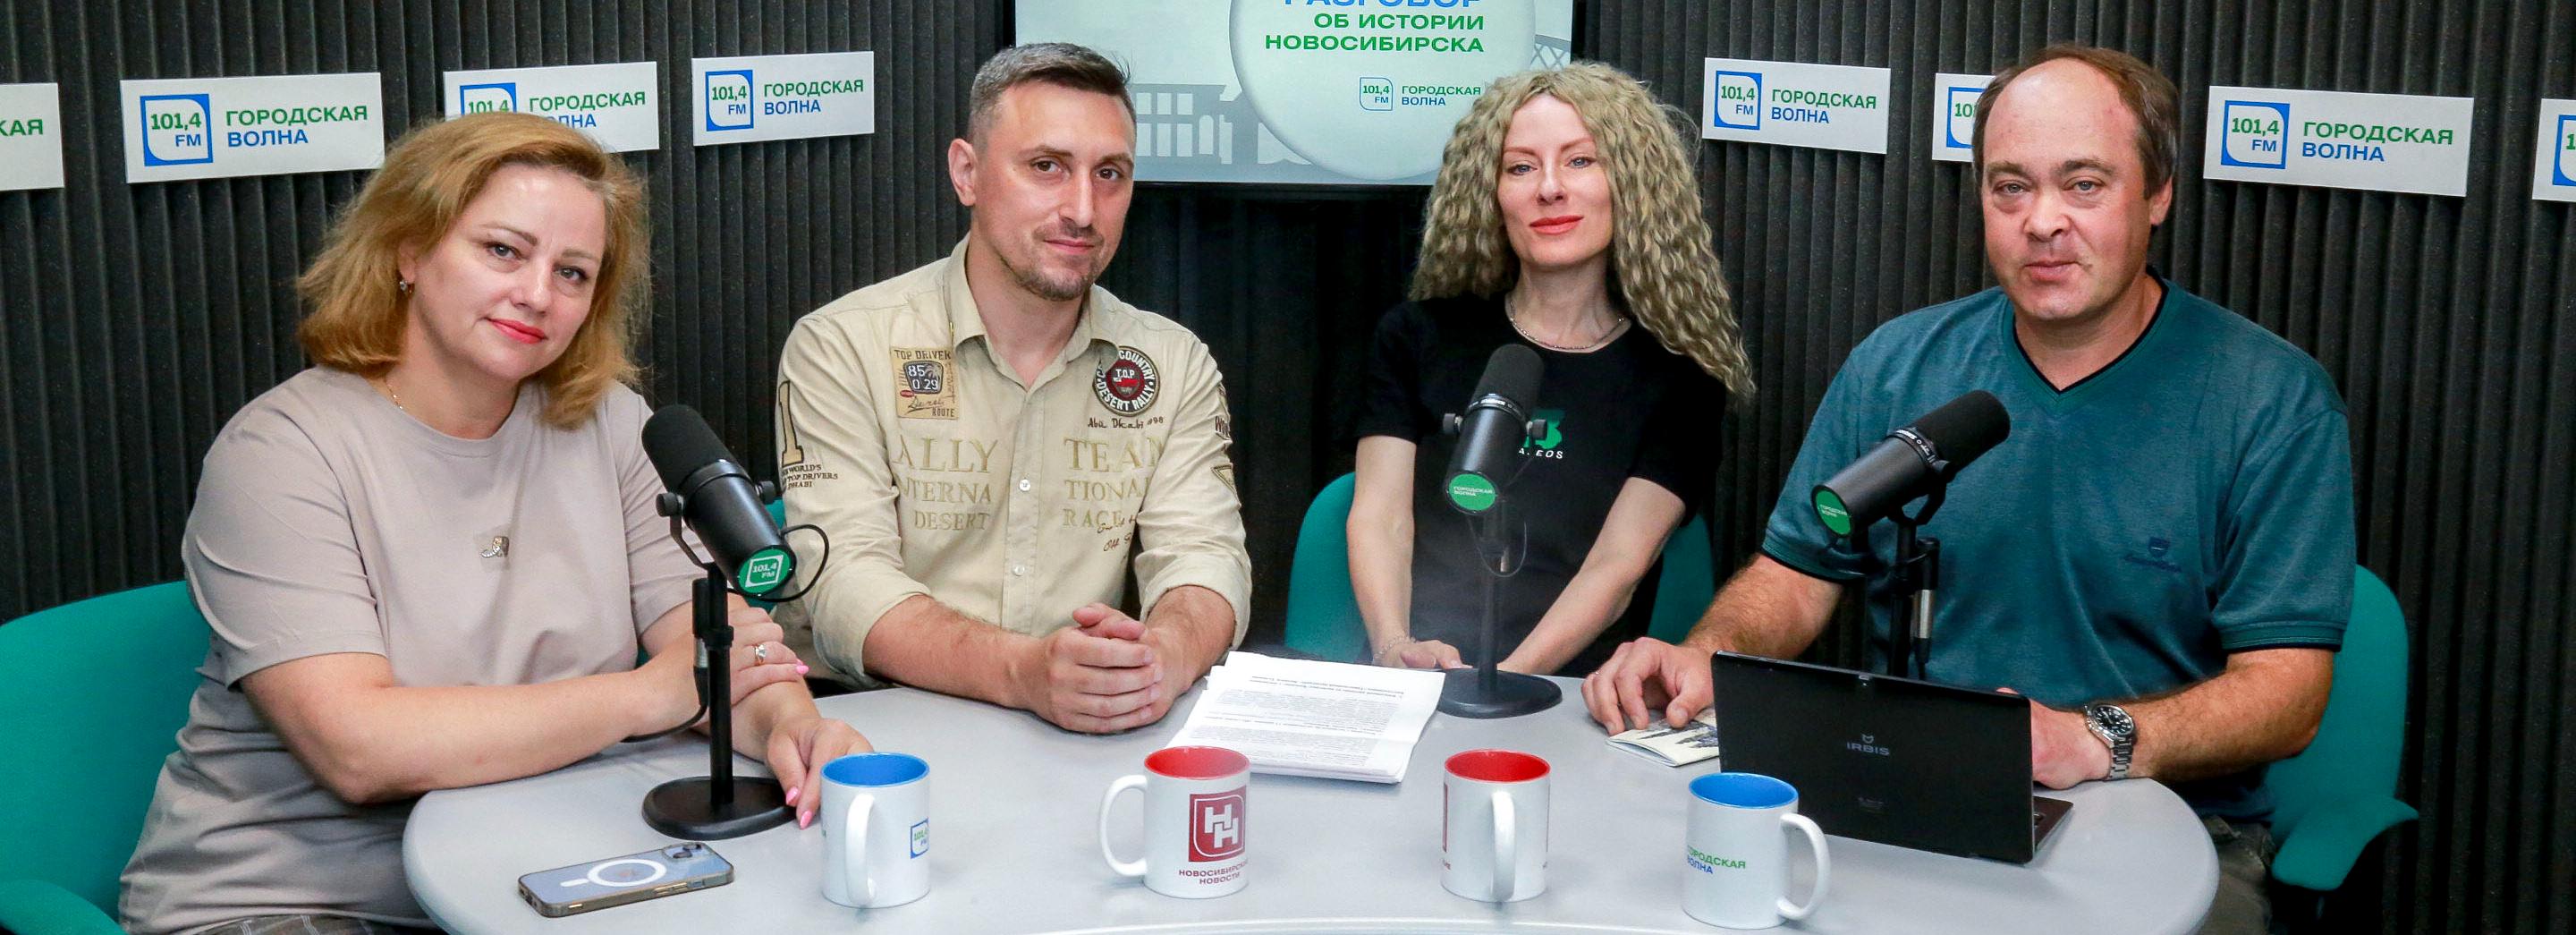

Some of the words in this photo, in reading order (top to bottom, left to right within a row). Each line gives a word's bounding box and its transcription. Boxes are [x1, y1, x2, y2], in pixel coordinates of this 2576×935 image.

[1313, 13, 1350, 29] ОБ
[1359, 13, 1485, 30] ИСТОРИИ
[1265, 34, 1485, 53] НОВОСИБИРСКА
[712, 86, 747, 102] 101,4
[764, 79, 864, 98] ГОРОДСКАЯ
[1362, 85, 1390, 95] 101,4
[1402, 85, 1481, 96] ГОРОДСКАЯ
[1721, 86, 1755, 102] 101,4
[530, 91, 646, 113] ГОРОДСКАЯ
[764, 99, 821, 115] ВОЛНА
[1374, 96, 1389, 104] FM
[1402, 97, 1446, 106] ВОЛНА
[1772, 89, 1877, 109] ГОРОДСКАЯ
[226, 106, 368, 126] ГОРОДСКАЯ
[728, 104, 746, 115] FM
[1735, 104, 1754, 115] FM
[1771, 106, 1829, 124] ВОЛНА
[150, 113, 202, 132] 101,4
[546, 114, 597, 129] ЛНА
[2232, 117, 2280, 137] 101,4
[175, 133, 201, 147] FM
[227, 129, 309, 148] ВОЛНА
[2303, 122, 2453, 145] ГОРОДСКАЯ
[2251, 139, 2276, 152] FM
[2302, 142, 2385, 162] ВОЛНА
[894, 350, 911, 360] TOP
[1118, 350, 1156, 381] COUNTRY
[1097, 381, 1130, 411] DESERT
[1131, 384, 1155, 410] RALLY
[914, 510, 990, 531] DESERT
[1846, 742, 1890, 756] IRBIS
